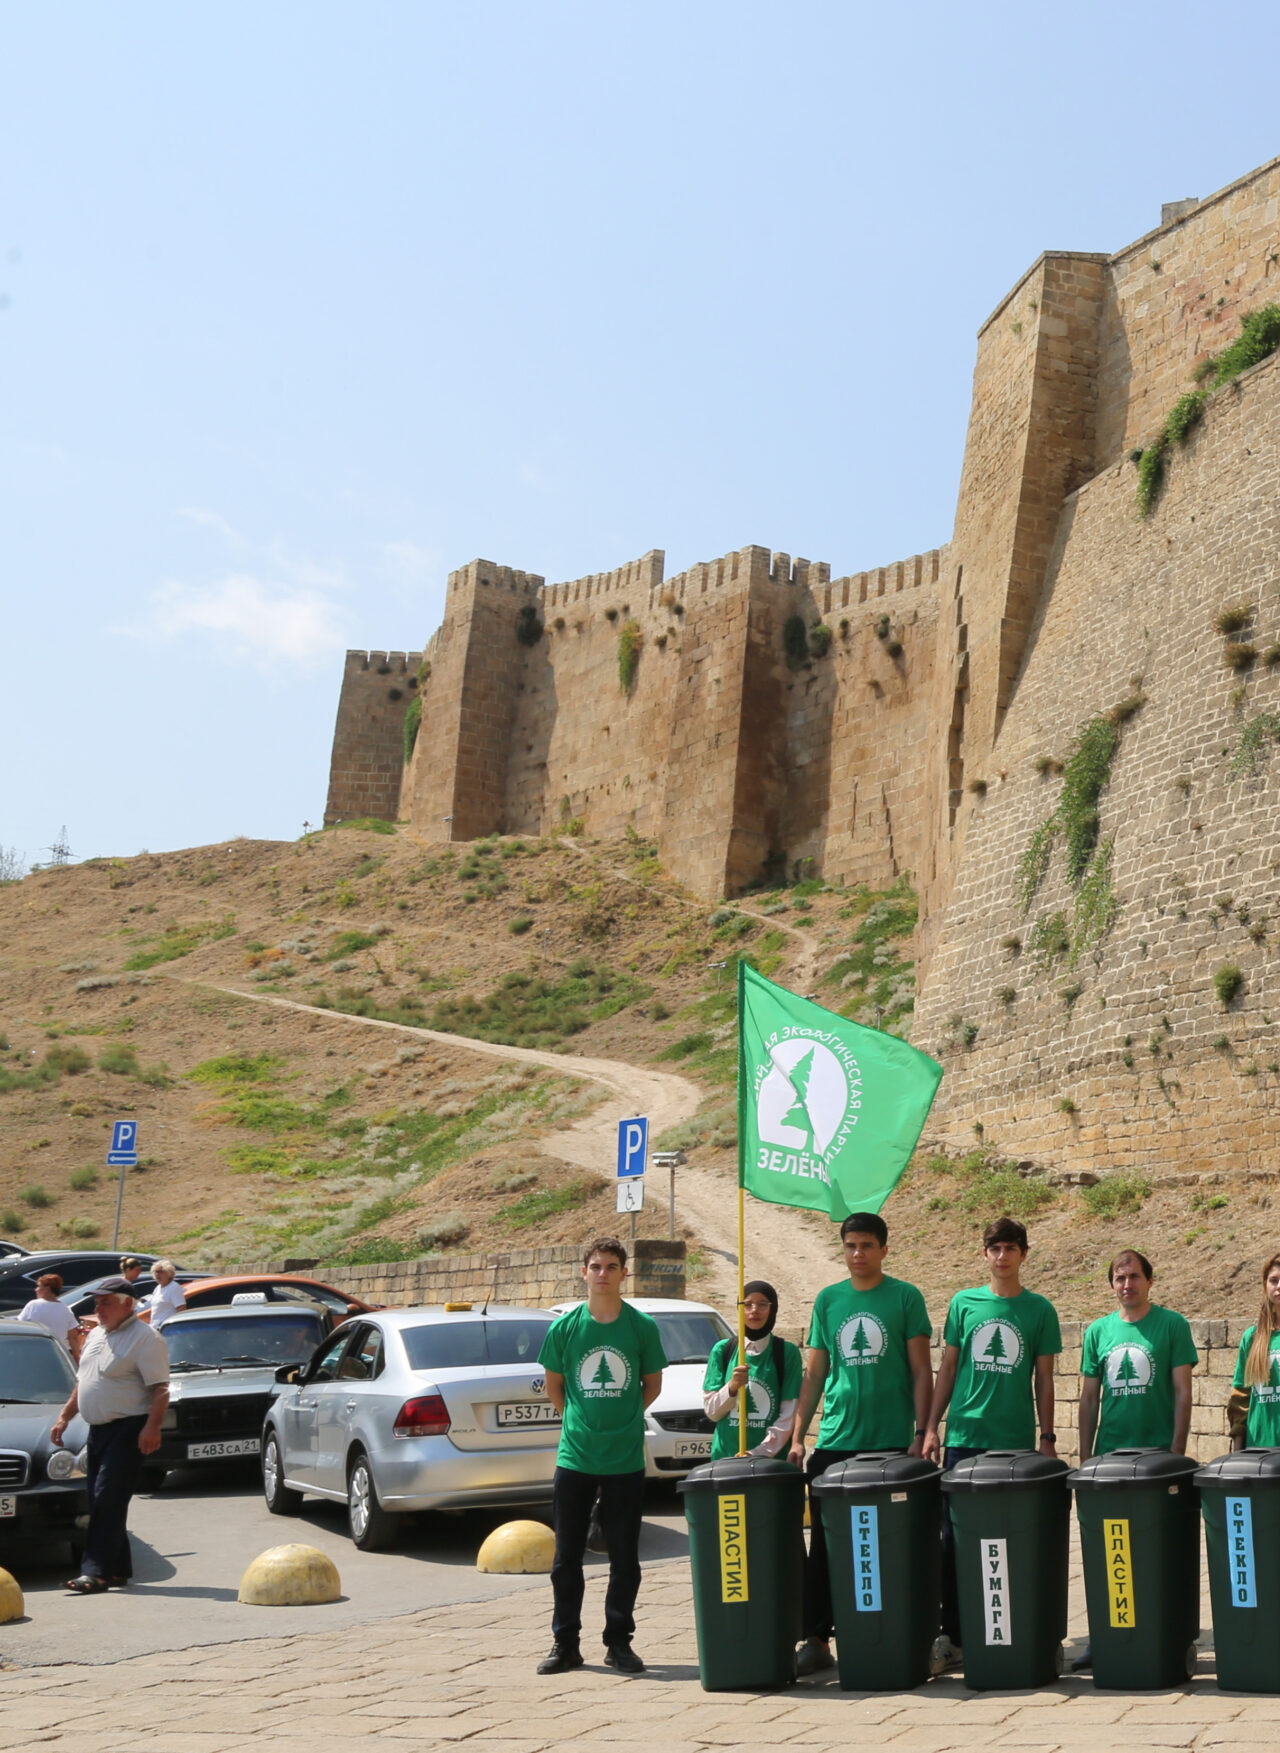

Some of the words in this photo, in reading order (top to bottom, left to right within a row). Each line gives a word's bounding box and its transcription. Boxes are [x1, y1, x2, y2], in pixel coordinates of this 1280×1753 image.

[117, 1124, 133, 1149] P
[625, 1124, 643, 1170] P
[824, 1113, 859, 1166] ПАРТИ
[845, 1357, 879, 1367] ЗЕЛЁНЫЕ
[975, 1362, 1013, 1374] ЗЕЛЁНЫЕ
[583, 1388, 622, 1398] ЗЕЛЁНЫЕ
[724, 1500, 743, 1598] ПЛАСТИК
[859, 1511, 873, 1606] СТЕКЛО
[1111, 1524, 1129, 1624] ПЛАСТИК
[1233, 1502, 1248, 1602] СТЕКЛО
[988, 1544, 1003, 1640] БУМАГА
